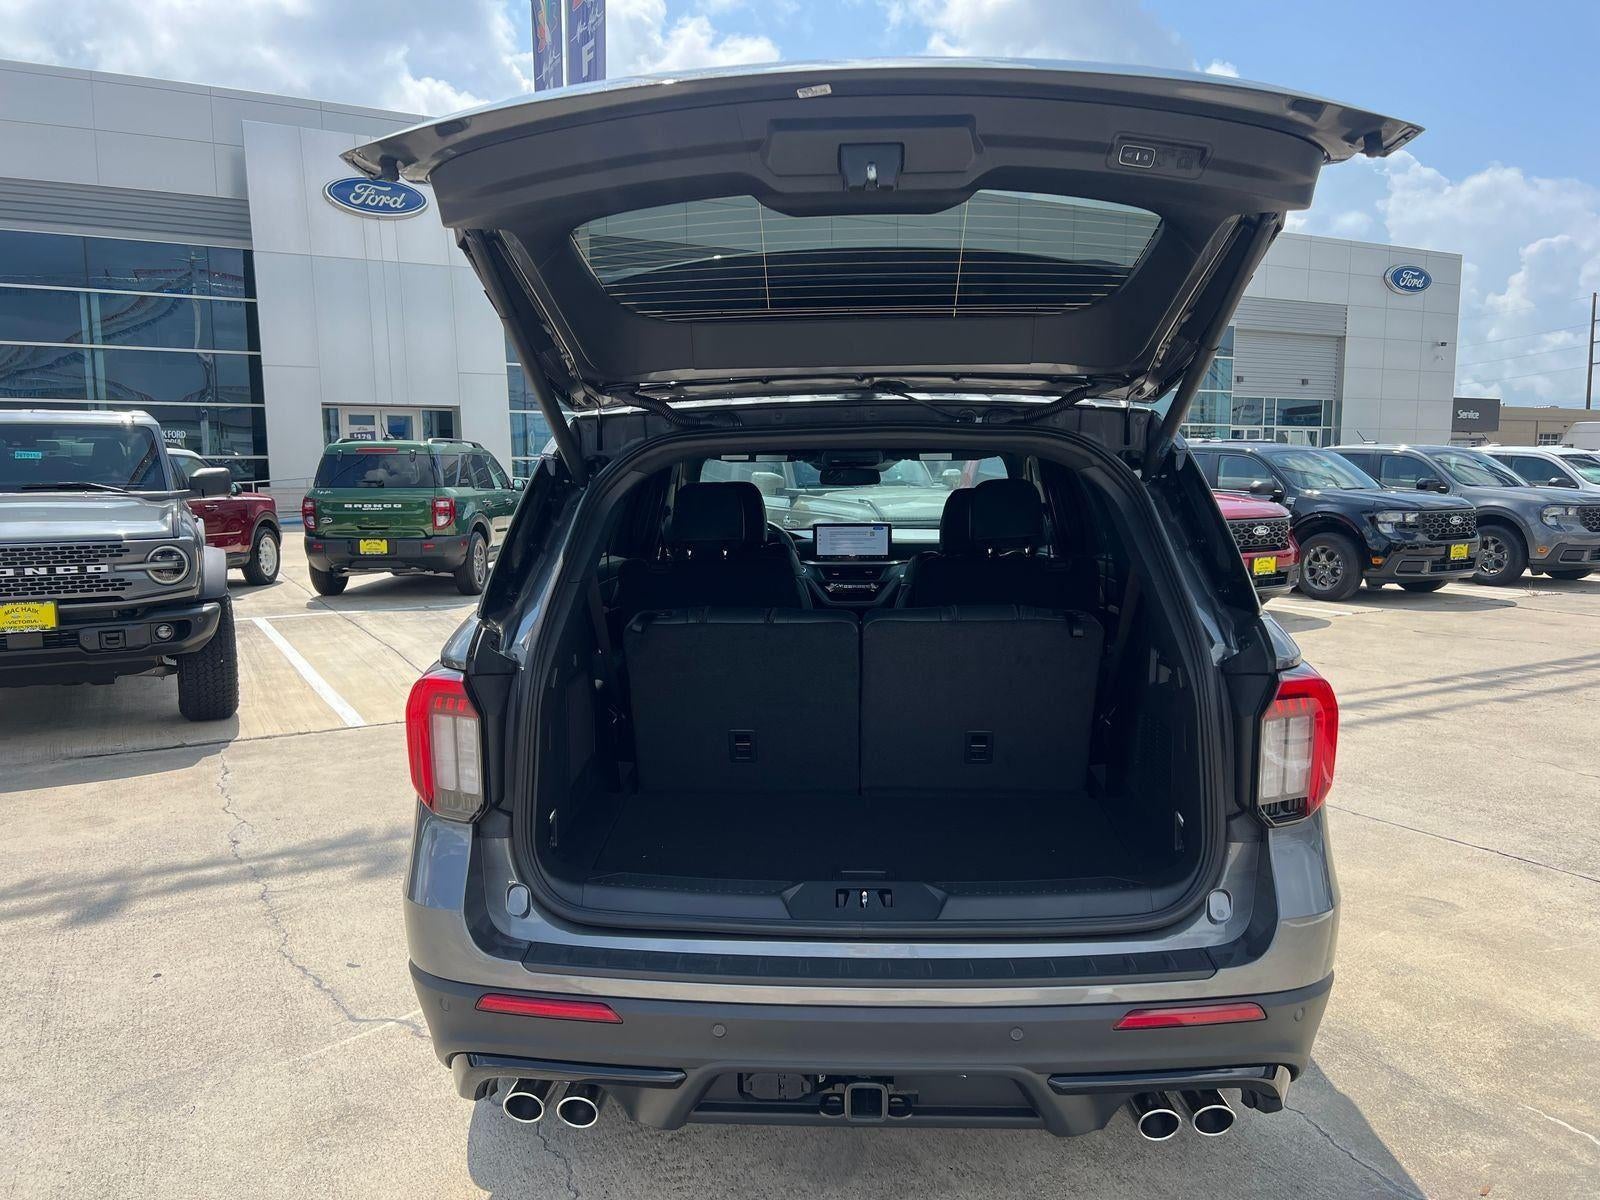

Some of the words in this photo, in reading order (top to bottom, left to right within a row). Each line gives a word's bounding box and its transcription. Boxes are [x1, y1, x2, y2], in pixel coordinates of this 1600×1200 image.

[349, 183, 406, 208] Ford
[1399, 270, 1425, 288] Ford
[1457, 409, 1480, 419] Service
[167, 430, 187, 439] FORD
[4, 607, 20, 616] MAC
[21, 606, 39, 615] HAIK
